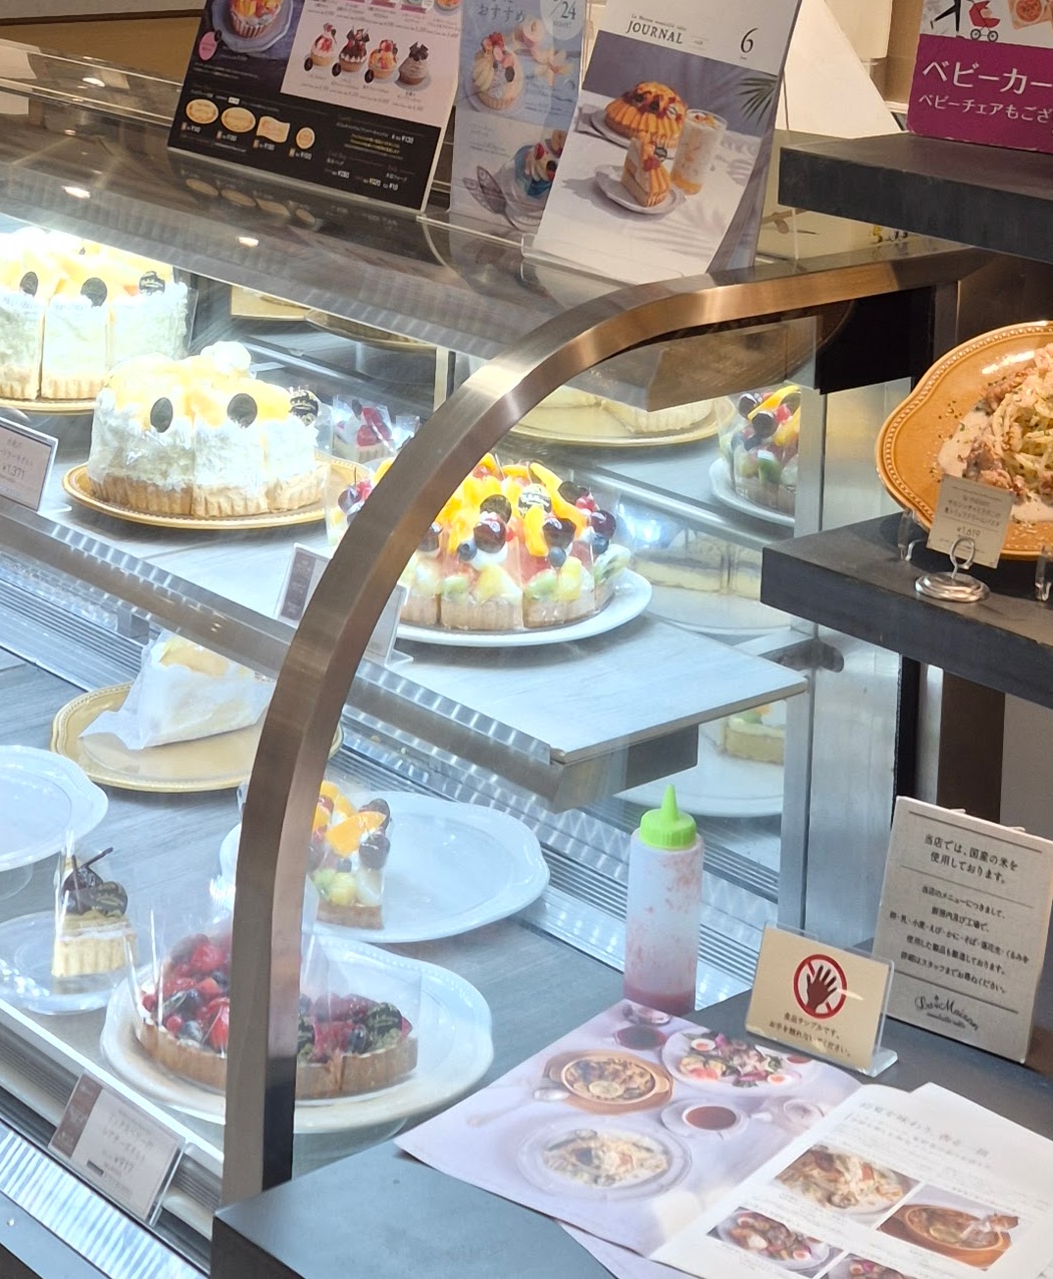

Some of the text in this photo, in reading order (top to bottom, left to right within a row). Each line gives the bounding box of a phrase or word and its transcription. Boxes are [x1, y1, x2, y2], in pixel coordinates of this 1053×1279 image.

[478, 3, 525, 23] おすすめ
[625, 20, 683, 44] JOURNAL
[740, 27, 758, 53] 6
[922, 61, 1053, 95] ベビーカー
[918, 94, 1053, 123] ベビーチェアもござ
[925, 833, 1018, 871] 当店では、国産の米を
[930, 851, 1005, 884] 使用しております。
